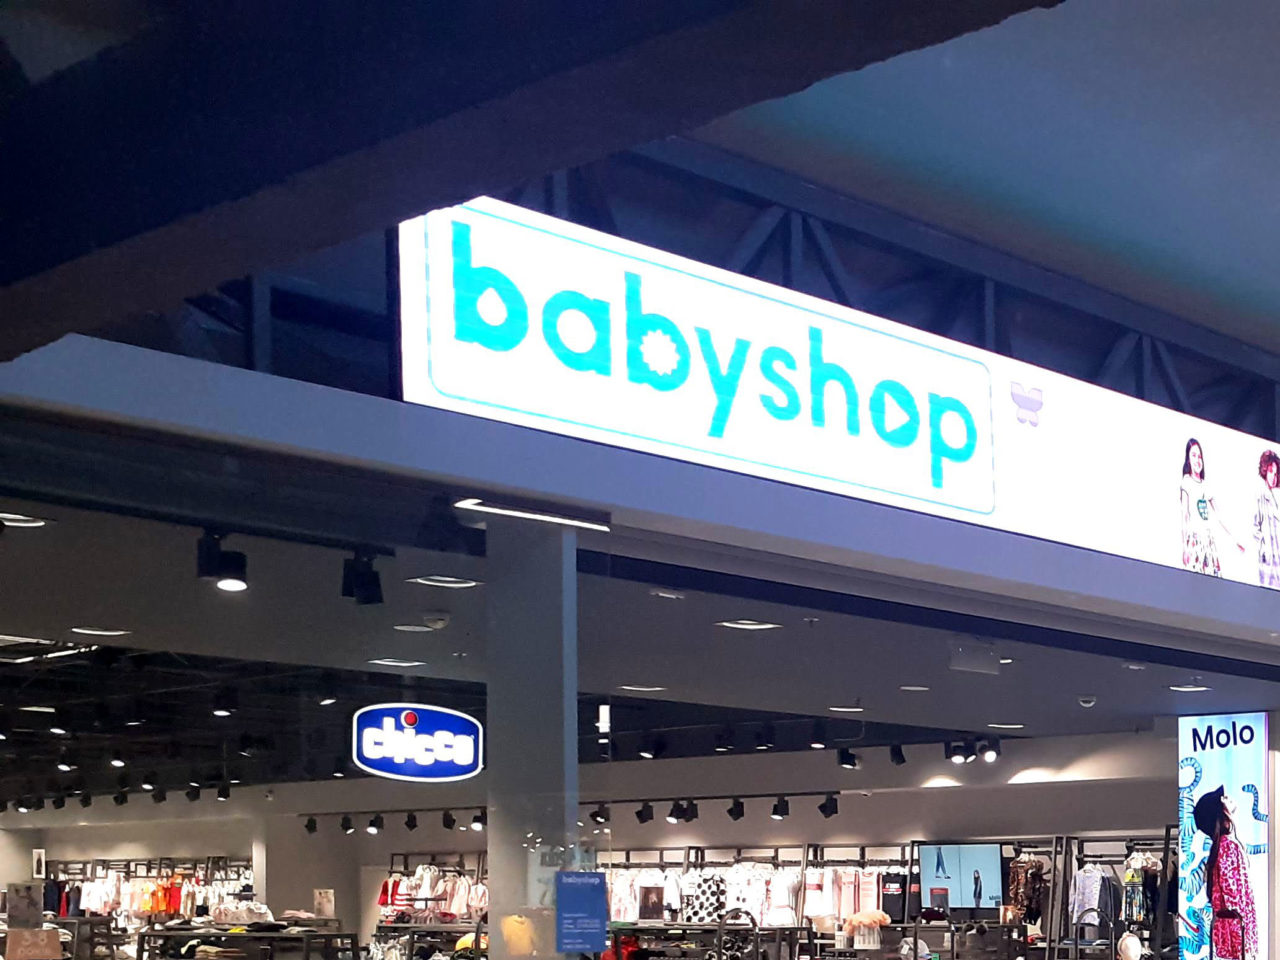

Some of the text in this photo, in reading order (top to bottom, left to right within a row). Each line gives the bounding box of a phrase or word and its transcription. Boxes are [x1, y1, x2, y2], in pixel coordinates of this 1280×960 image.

[451, 220, 977, 488] babyshop
[362, 710, 475, 766] chicco
[1192, 720, 1255, 752] Molo
